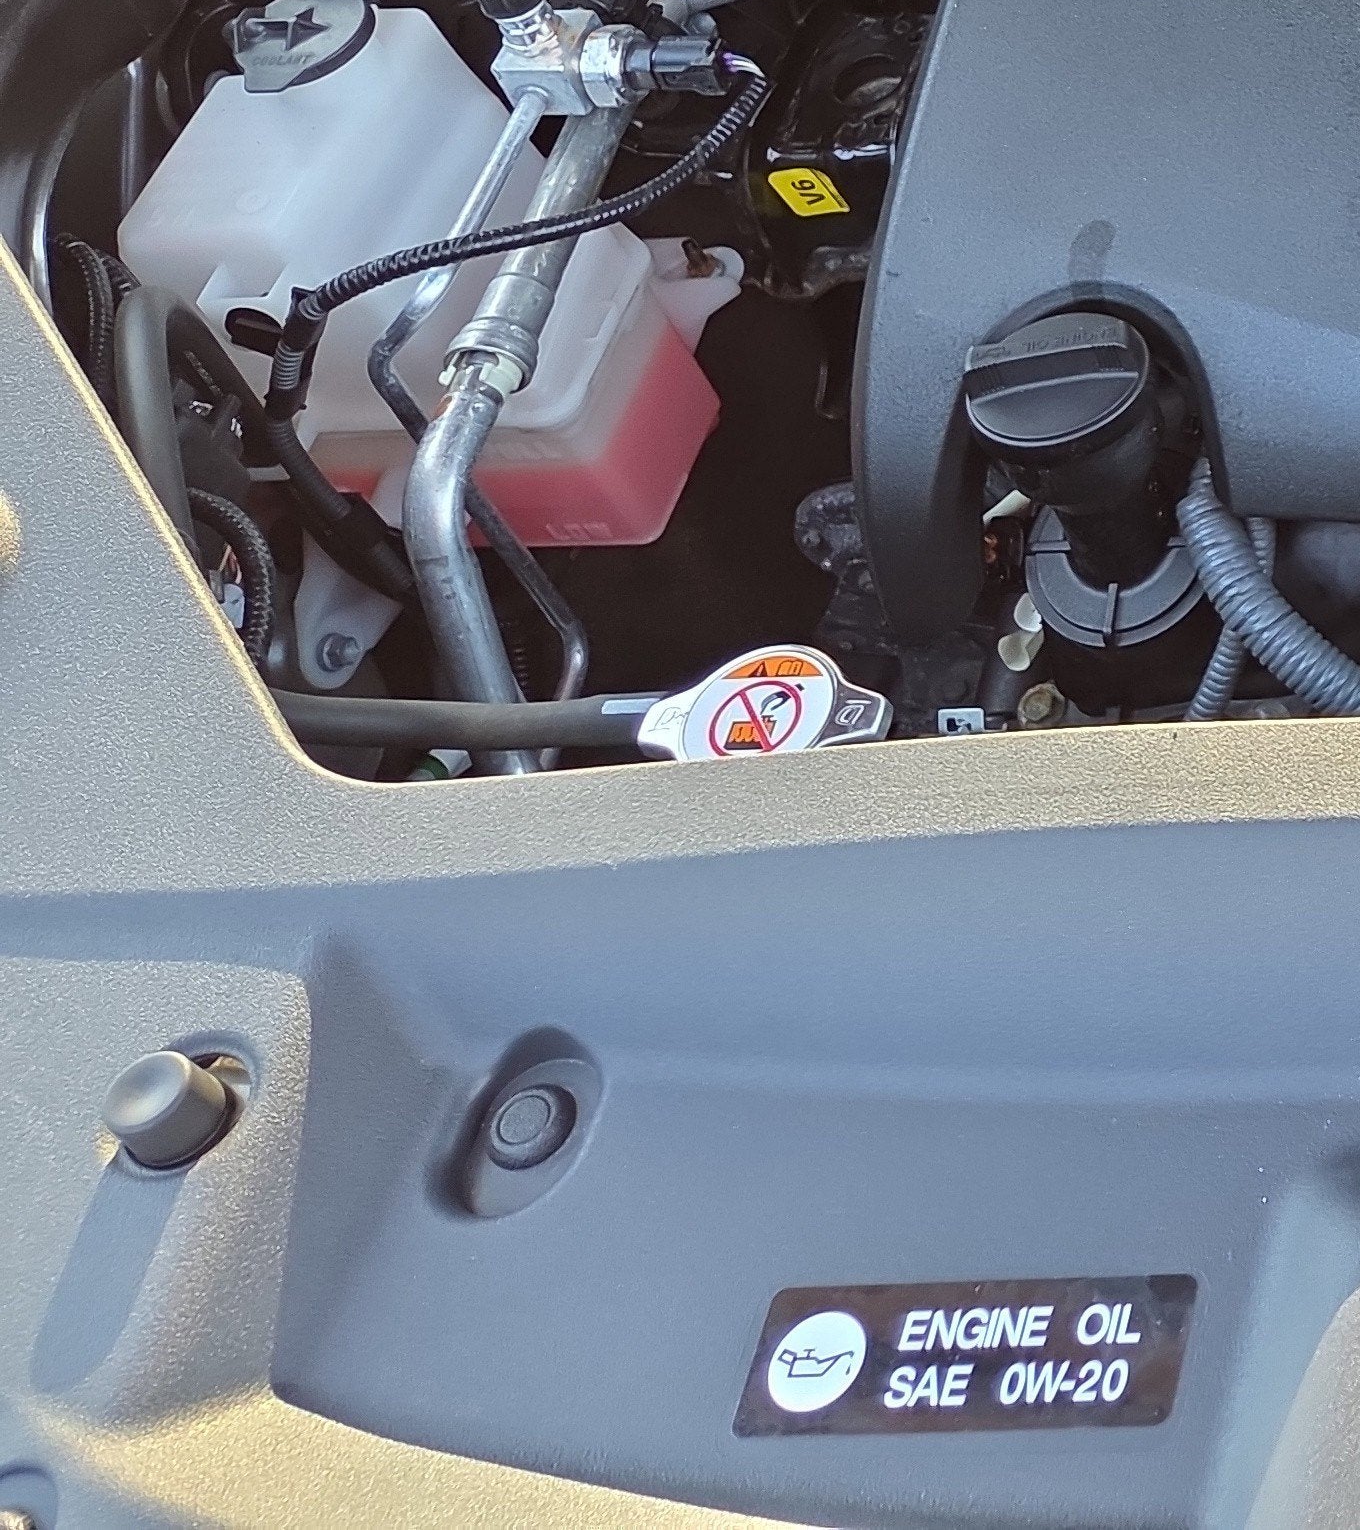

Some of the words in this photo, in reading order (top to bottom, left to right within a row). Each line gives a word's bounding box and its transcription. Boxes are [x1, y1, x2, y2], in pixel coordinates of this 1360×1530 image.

[897, 1305, 1055, 1352] ENGINE
[1076, 1302, 1141, 1346] OIL
[883, 1364, 976, 1409] SAE
[999, 1358, 1131, 1406] 0W-20
